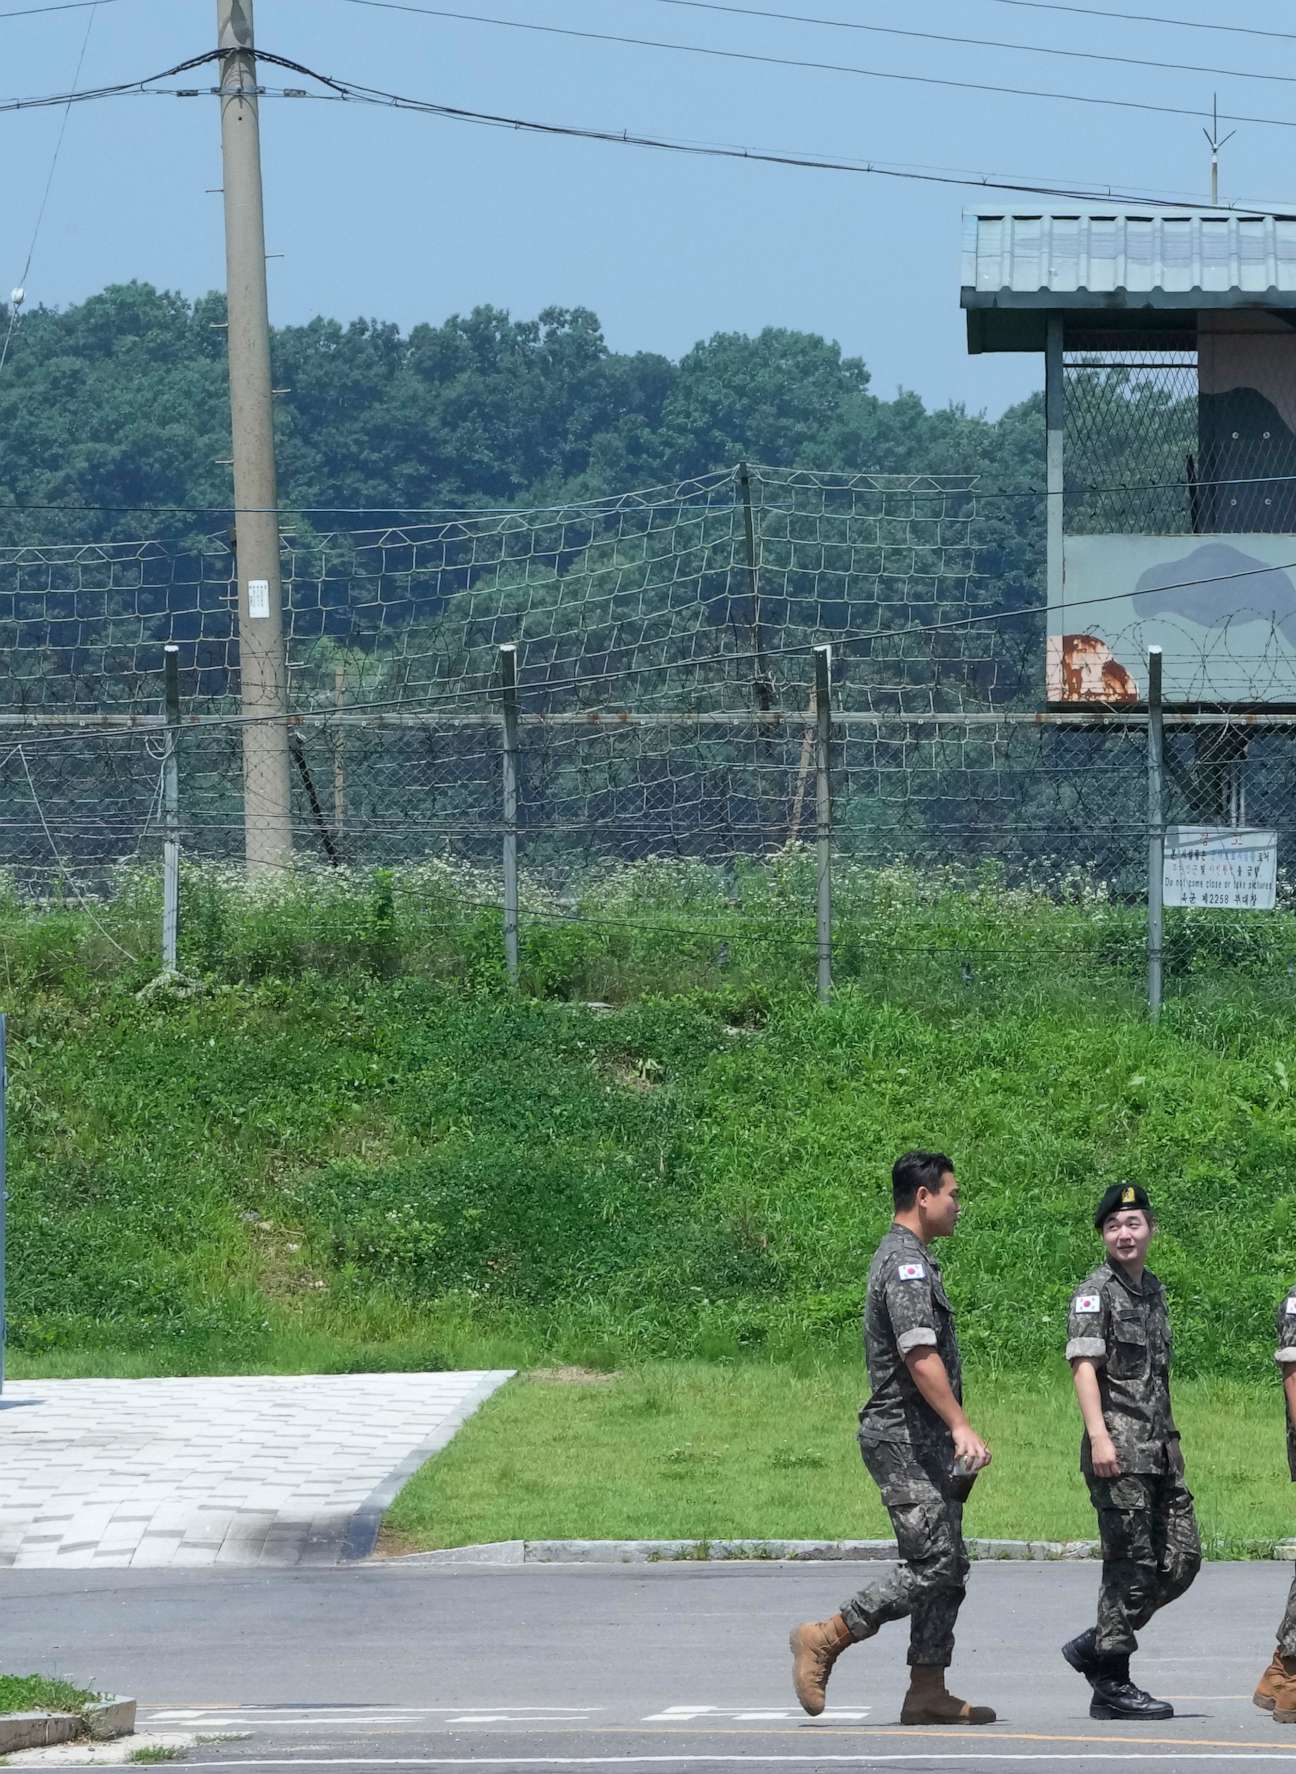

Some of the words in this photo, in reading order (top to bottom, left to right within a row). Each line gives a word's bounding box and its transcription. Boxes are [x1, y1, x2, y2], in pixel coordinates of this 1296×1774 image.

[1165, 877, 1174, 888] Do
[1206, 879, 1222, 890] close
[1224, 881, 1231, 889] or
